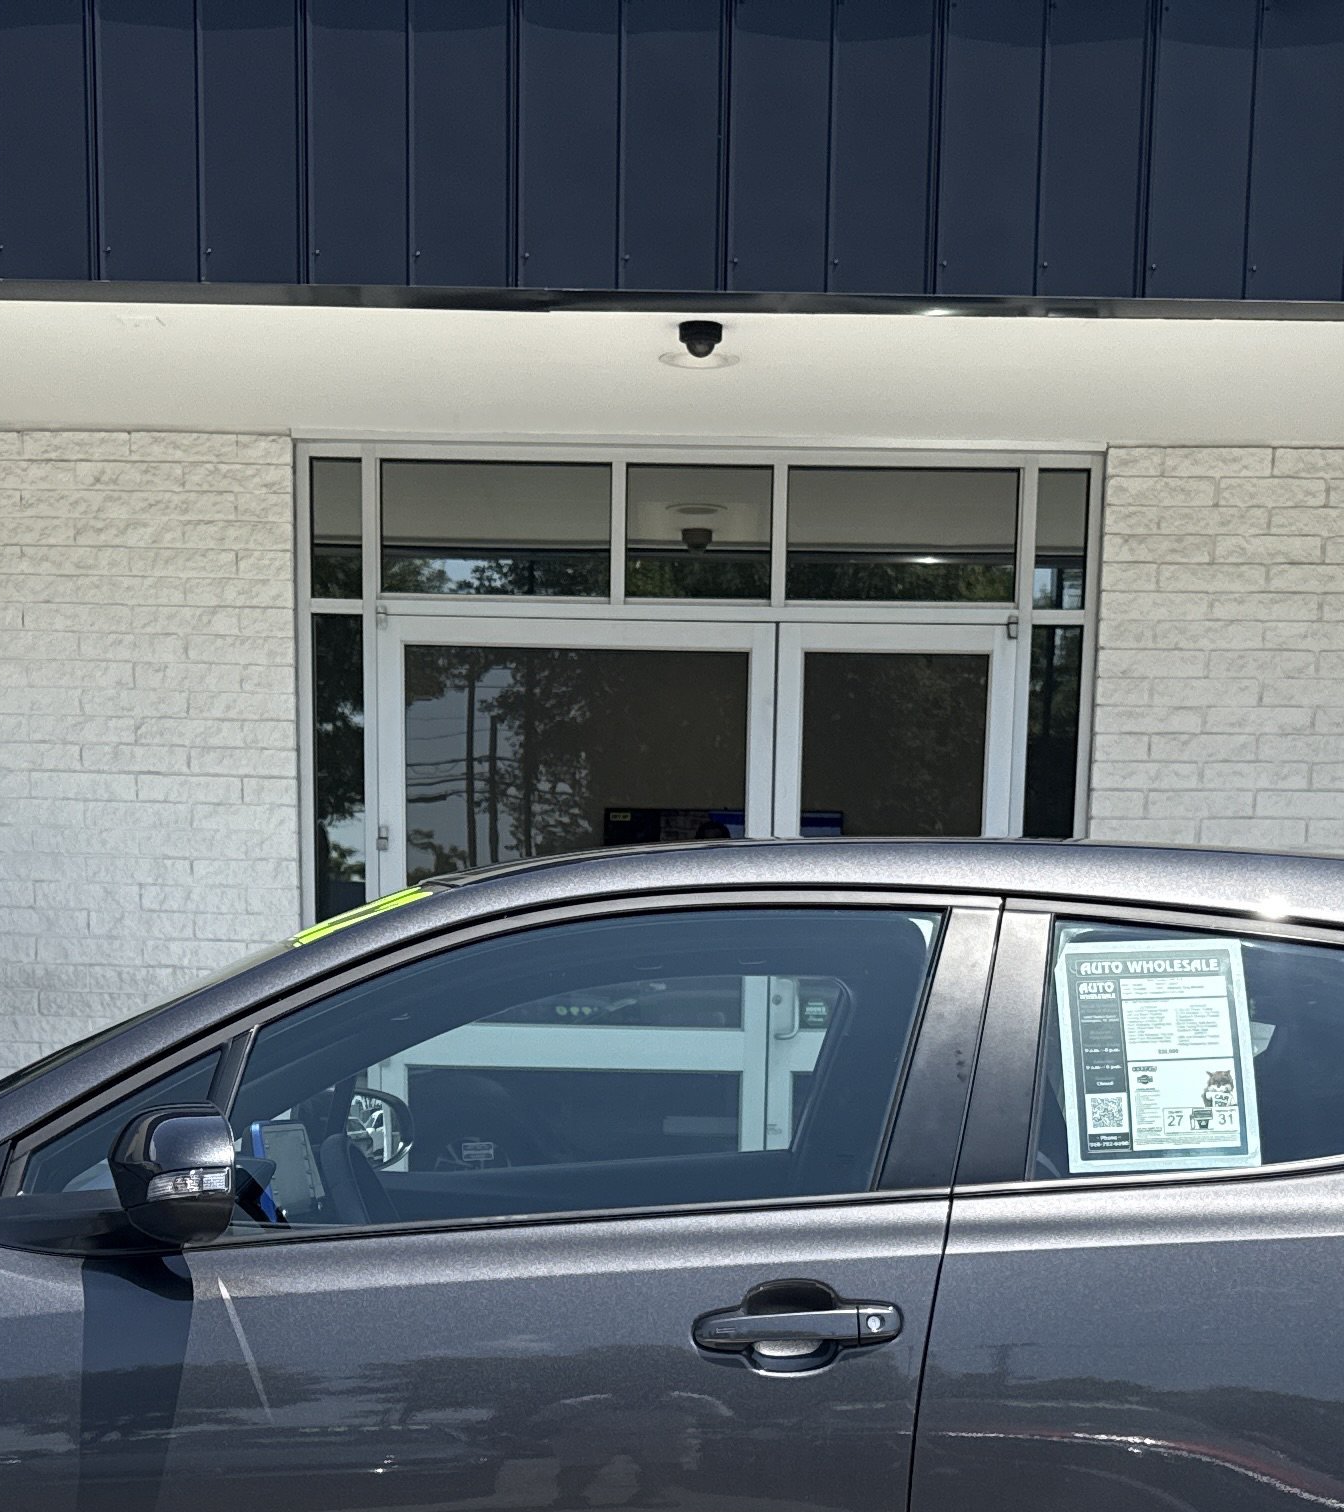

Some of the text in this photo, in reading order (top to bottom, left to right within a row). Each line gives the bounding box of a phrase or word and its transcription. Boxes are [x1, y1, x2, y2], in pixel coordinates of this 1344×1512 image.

[1080, 958, 1219, 976] AUTO WHOLESALE
[1079, 981, 1115, 994] AUTO
[1167, 1115, 1183, 1126] 27
[1218, 1113, 1233, 1125] 31
